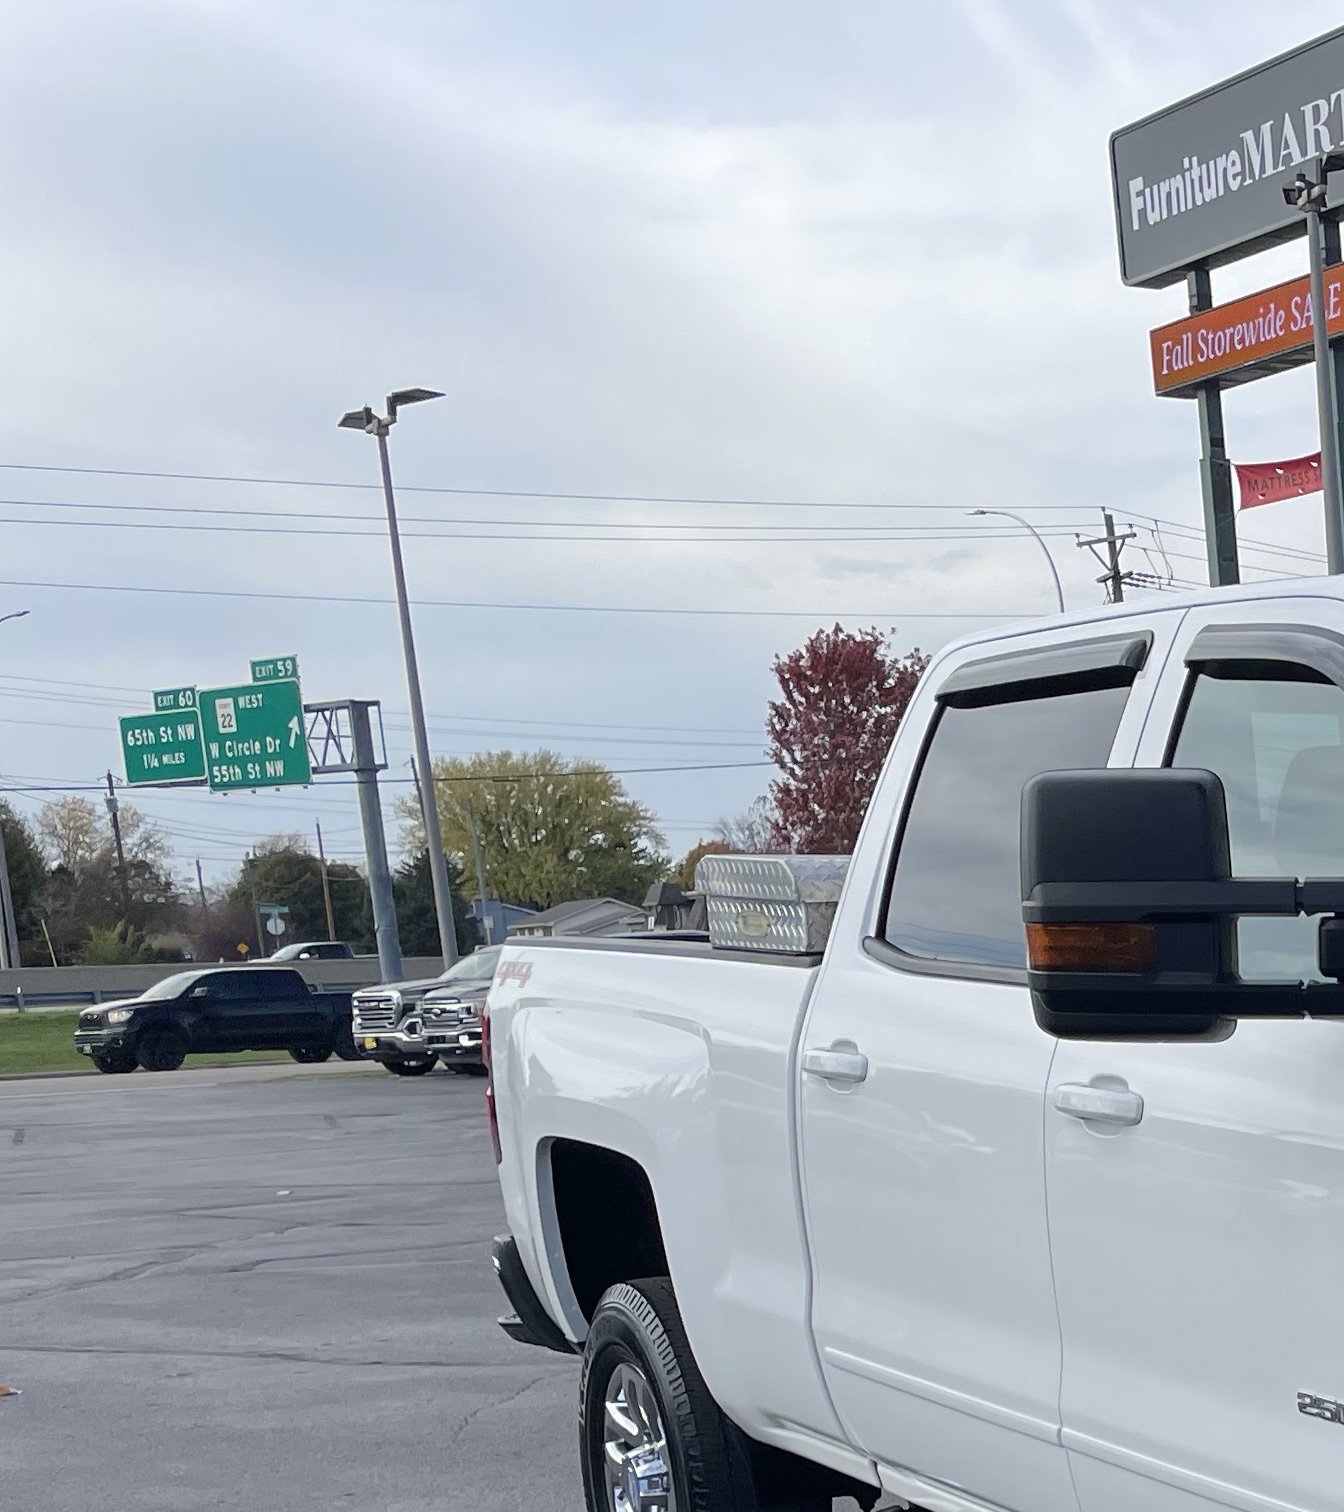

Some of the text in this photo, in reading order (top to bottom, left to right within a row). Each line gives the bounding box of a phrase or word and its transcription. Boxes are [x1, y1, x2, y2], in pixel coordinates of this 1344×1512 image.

[1161, 282, 1341, 375] Fall Storewide SAE
[1247, 470, 1311, 492] MATTRESS
[255, 659, 293, 678] EXIT 59
[157, 690, 194, 707] EXIT 60
[237, 693, 263, 709] WEST
[220, 713, 234, 729] 22
[127, 723, 195, 747] 65th St NW
[209, 736, 281, 759] W Circle Dr
[162, 752, 185, 765] MILES
[212, 759, 284, 783] 55th St NW
